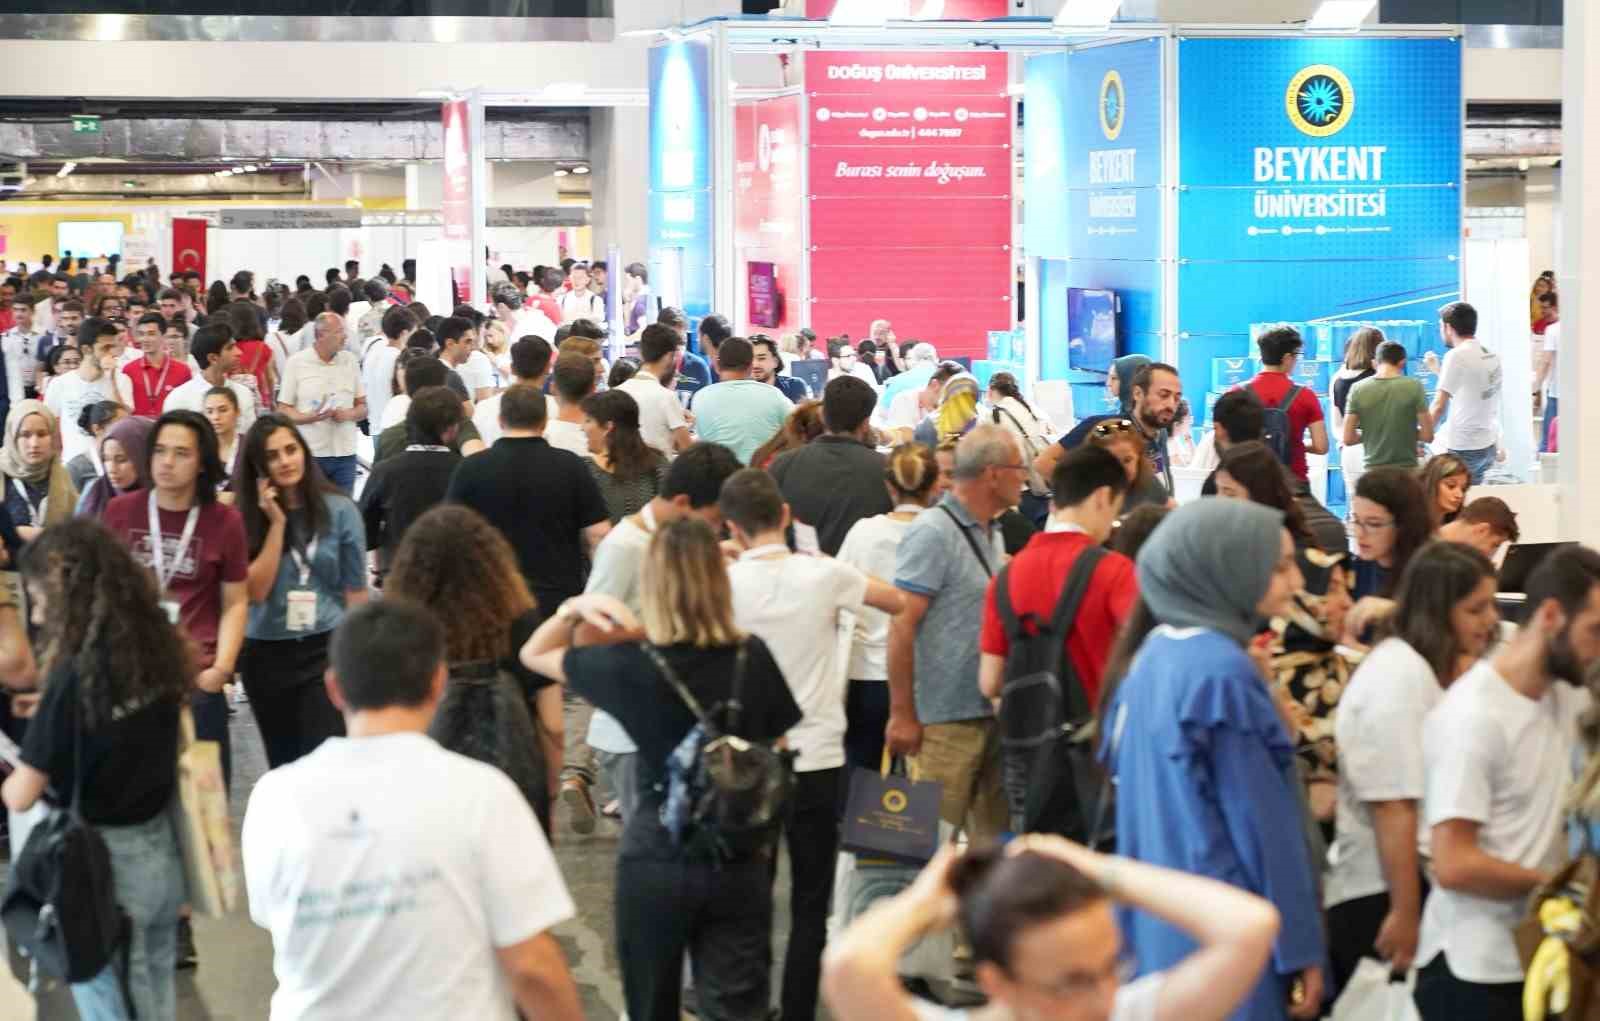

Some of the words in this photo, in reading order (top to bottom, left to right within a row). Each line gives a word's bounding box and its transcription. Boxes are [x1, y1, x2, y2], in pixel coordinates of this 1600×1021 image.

[829, 64, 882, 82] DOĞUŞ
[835, 160, 883, 177] Burası
[886, 161, 922, 177] senin
[1254, 145, 1387, 182] BEYKENT
[1254, 187, 1387, 218] ÜNİVERSİTESİ
